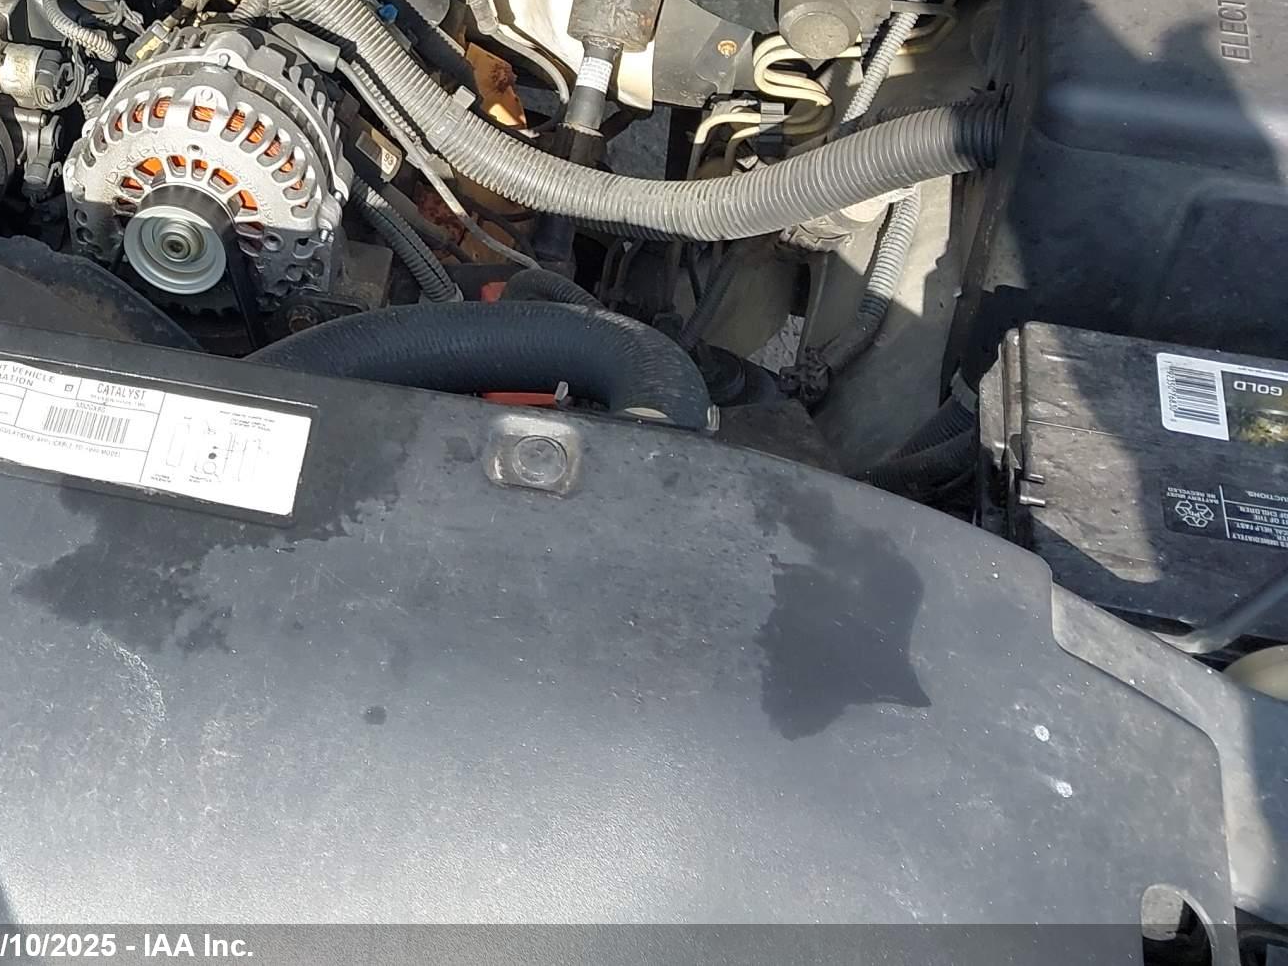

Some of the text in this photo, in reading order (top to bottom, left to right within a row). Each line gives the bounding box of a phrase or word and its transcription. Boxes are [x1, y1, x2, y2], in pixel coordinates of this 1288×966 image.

[11, 364, 56, 384] VEHICLE
[96, 382, 147, 400] CATALYST
[1233, 380, 1283, 396] GOLD
